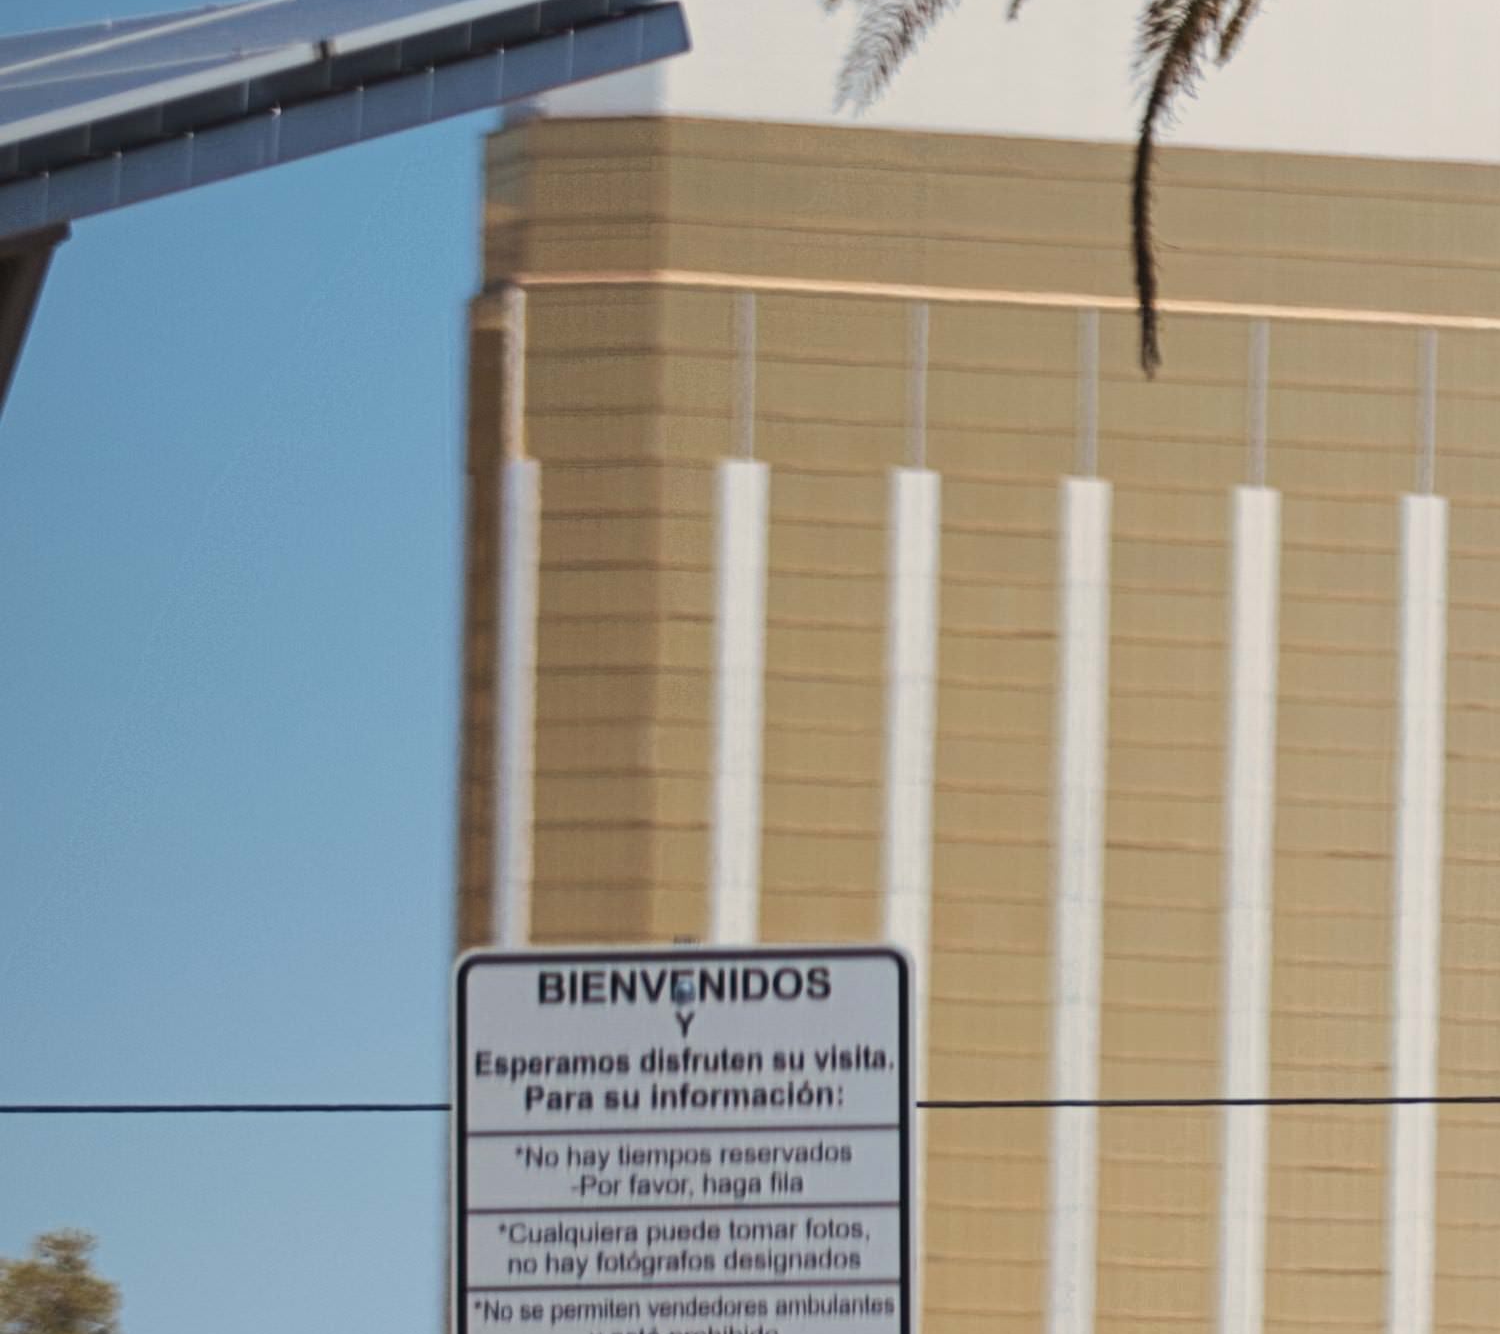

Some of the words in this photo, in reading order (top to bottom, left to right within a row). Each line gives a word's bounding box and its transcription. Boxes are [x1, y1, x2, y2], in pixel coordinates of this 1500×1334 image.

[538, 967, 832, 1006] BIENVENIDOS
[676, 1012, 695, 1038] Y
[475, 1050, 630, 1081] Esperamos
[640, 1048, 762, 1076] disfruten
[773, 1049, 804, 1071] su
[814, 1044, 895, 1071] visita.
[524, 1085, 593, 1112] Para
[605, 1087, 640, 1109] su
[567, 1143, 610, 1171] hay
[618, 1145, 712, 1171] tiempos
[720, 1141, 852, 1166] reservados
[703, 1175, 761, 1199] haga
[770, 1173, 803, 1193] fila
[647, 1223, 720, 1246] puede
[729, 1222, 798, 1242] tomar
[508, 1251, 536, 1276] no
[546, 1249, 588, 1278] hay
[724, 1246, 861, 1275] designados
[520, 1300, 544, 1320] se
[550, 1297, 640, 1324] permiten
[648, 1295, 768, 1319] vendedores
[775, 1293, 895, 1317] ambulantes
